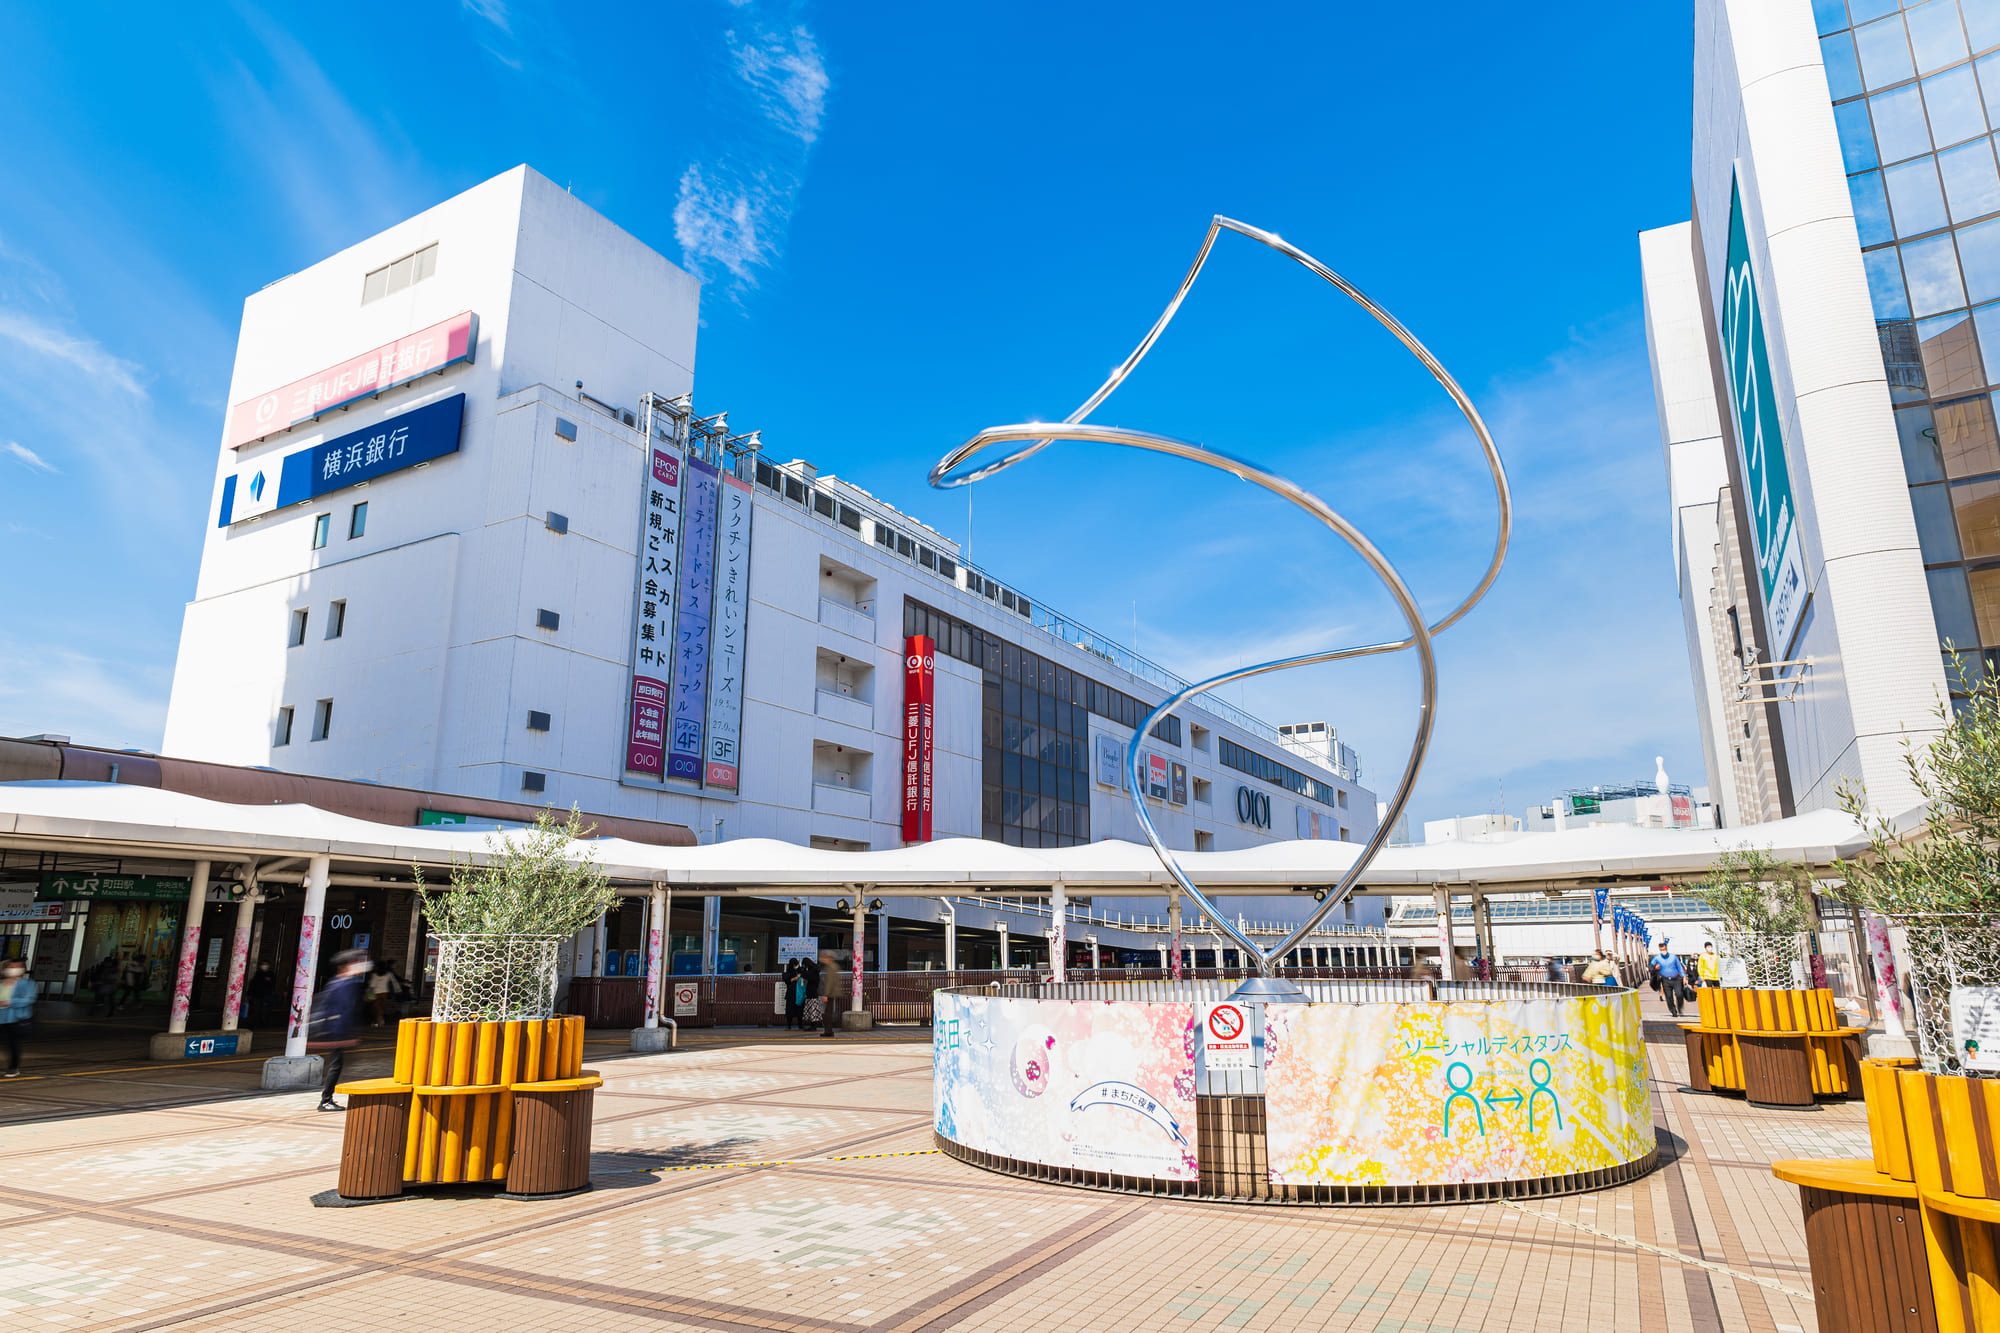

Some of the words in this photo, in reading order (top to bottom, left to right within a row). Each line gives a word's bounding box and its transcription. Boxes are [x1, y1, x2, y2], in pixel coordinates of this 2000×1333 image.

[290, 338, 434, 414] 三菱UFJ信託銀行
[322, 427, 410, 481] 横浜銀行
[655, 457, 678, 476] EPOS
[657, 471, 674, 481] CARD
[640, 490, 664, 665] 新規ご入会募集中
[688, 481, 708, 609] パーティードレス
[656, 497, 677, 667] エポスカード
[720, 494, 743, 693] ラクチンきれいシューズ
[676, 631, 692, 713] フォーマル
[693, 625, 707, 692] ブラック
[677, 732, 698, 749] 4F
[714, 741, 732, 758] 3F
[906, 702, 919, 812] 三菱UFJ信託銀行
[922, 703, 932, 812] 三菱UFJ信託銀行
[72, 878, 99, 892] JR
[1405, 1033, 1573, 1057] ソーシャルディスタンス
